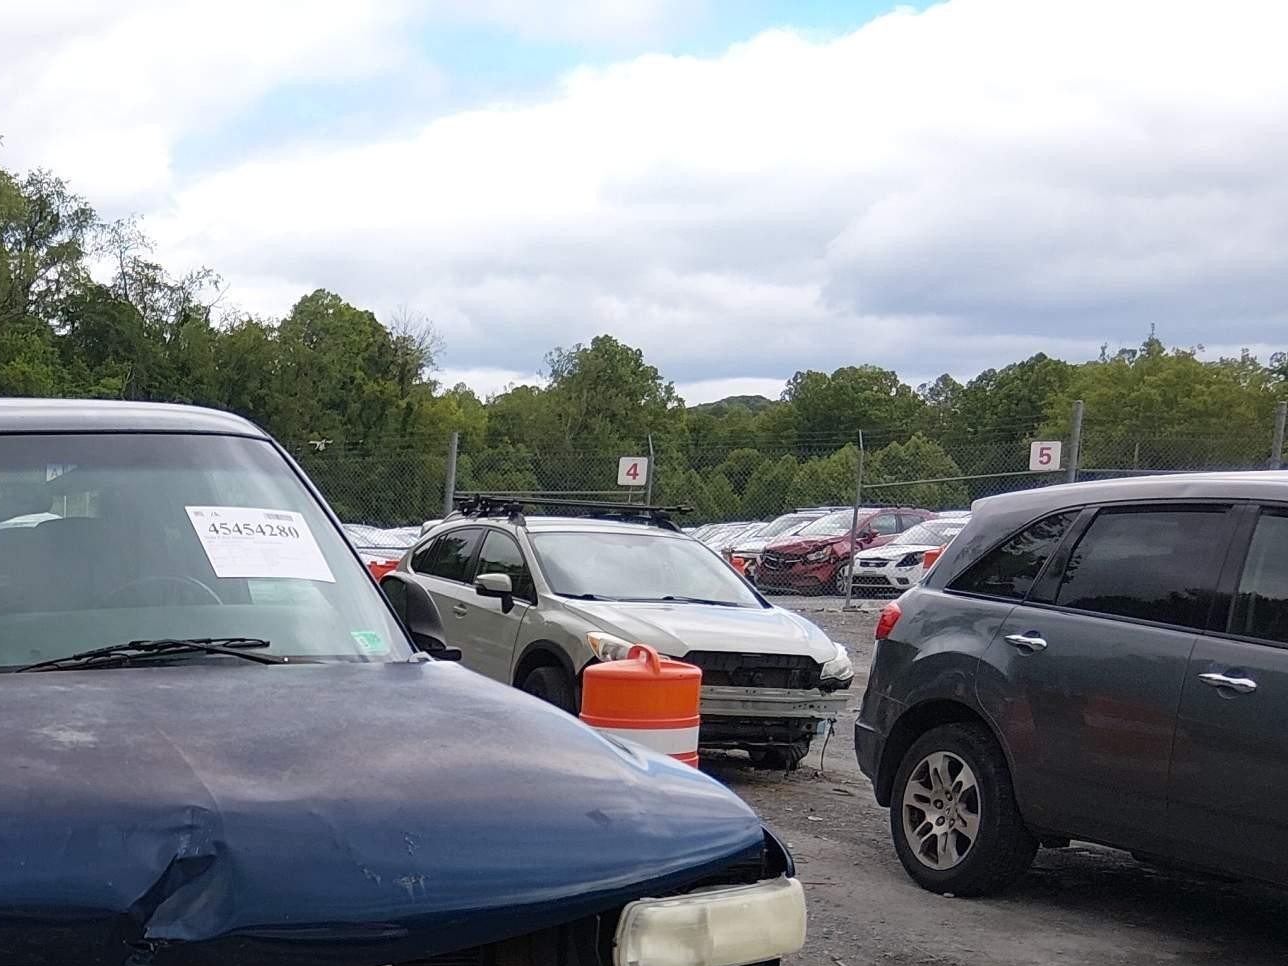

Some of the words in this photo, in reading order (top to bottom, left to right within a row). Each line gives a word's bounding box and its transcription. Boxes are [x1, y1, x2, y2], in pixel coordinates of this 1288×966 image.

[1038, 446, 1052, 465] 5
[625, 463, 639, 480] 4
[208, 522, 300, 539] 45454280
